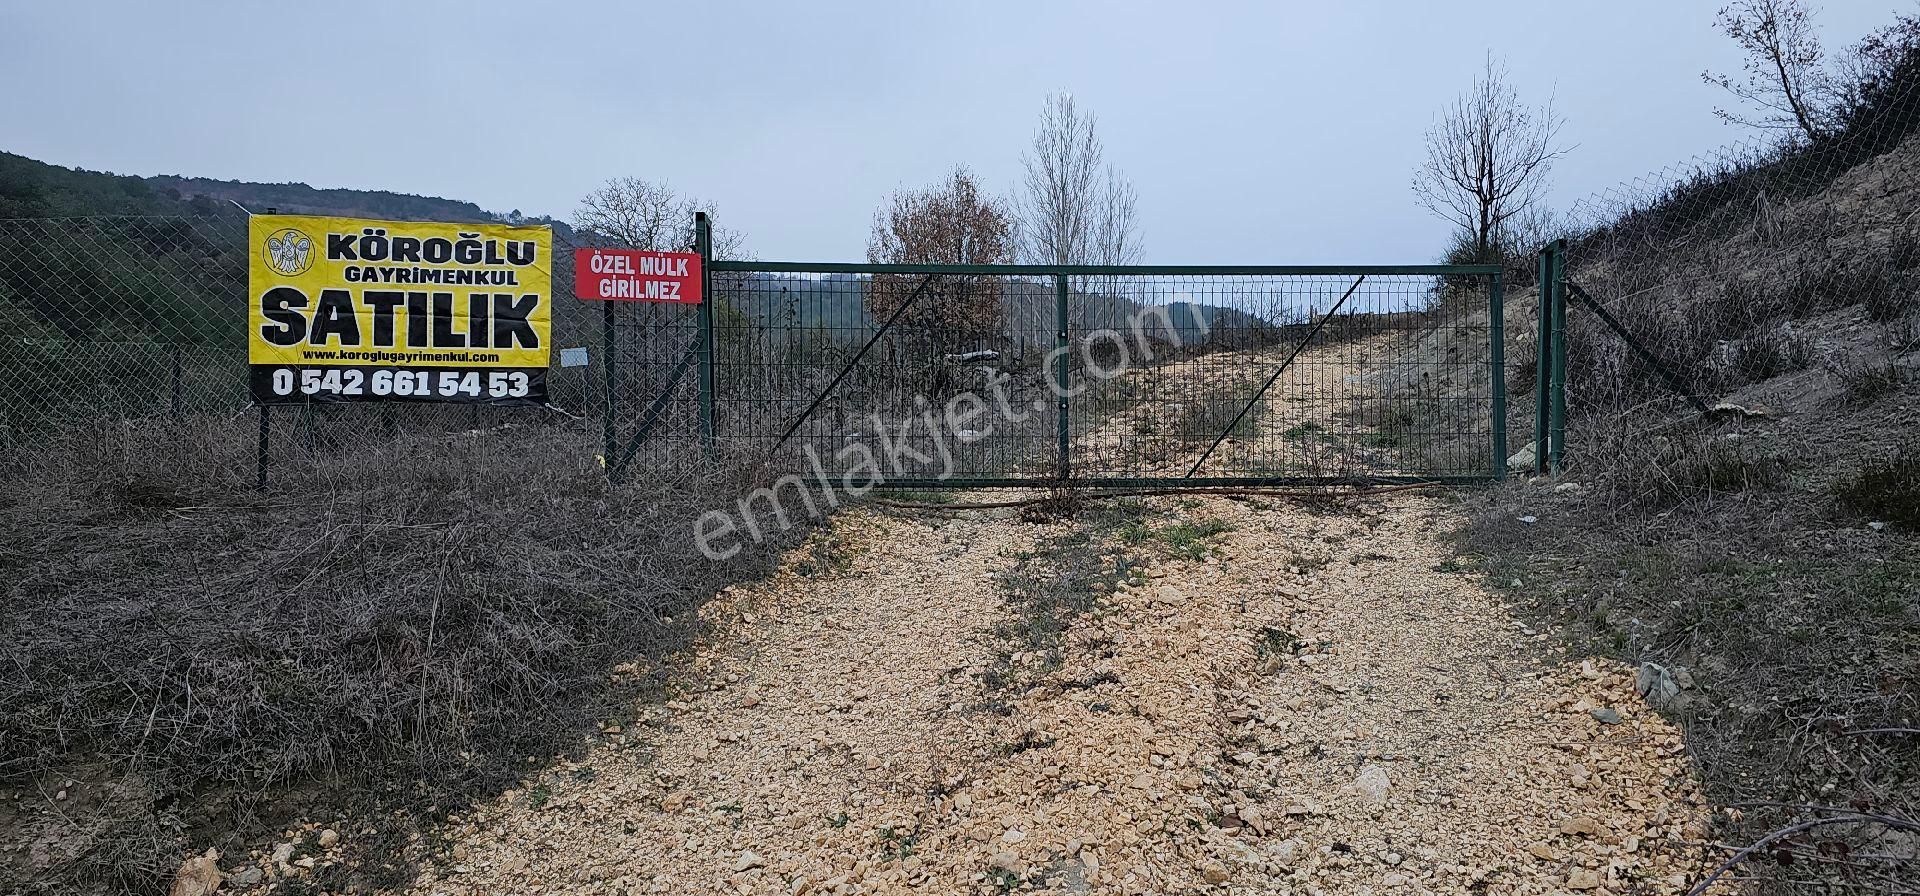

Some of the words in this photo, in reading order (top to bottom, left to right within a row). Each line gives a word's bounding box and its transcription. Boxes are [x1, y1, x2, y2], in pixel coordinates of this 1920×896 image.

[327, 228, 536, 266] KÖROĞLU
[344, 266, 519, 286] GAYRİMENKUL
[590, 250, 635, 274] ÖZEL
[640, 253, 689, 277] MÜLK
[599, 275, 681, 300] GİRİLMEZ
[261, 287, 539, 349] SATILIK
[303, 349, 500, 363] www.koroglugayrimenkul.com
[272, 369, 294, 396] 0
[300, 369, 363, 396] 542
[371, 371, 431, 396] 661
[438, 371, 481, 397] 54
[488, 372, 529, 397] 53
